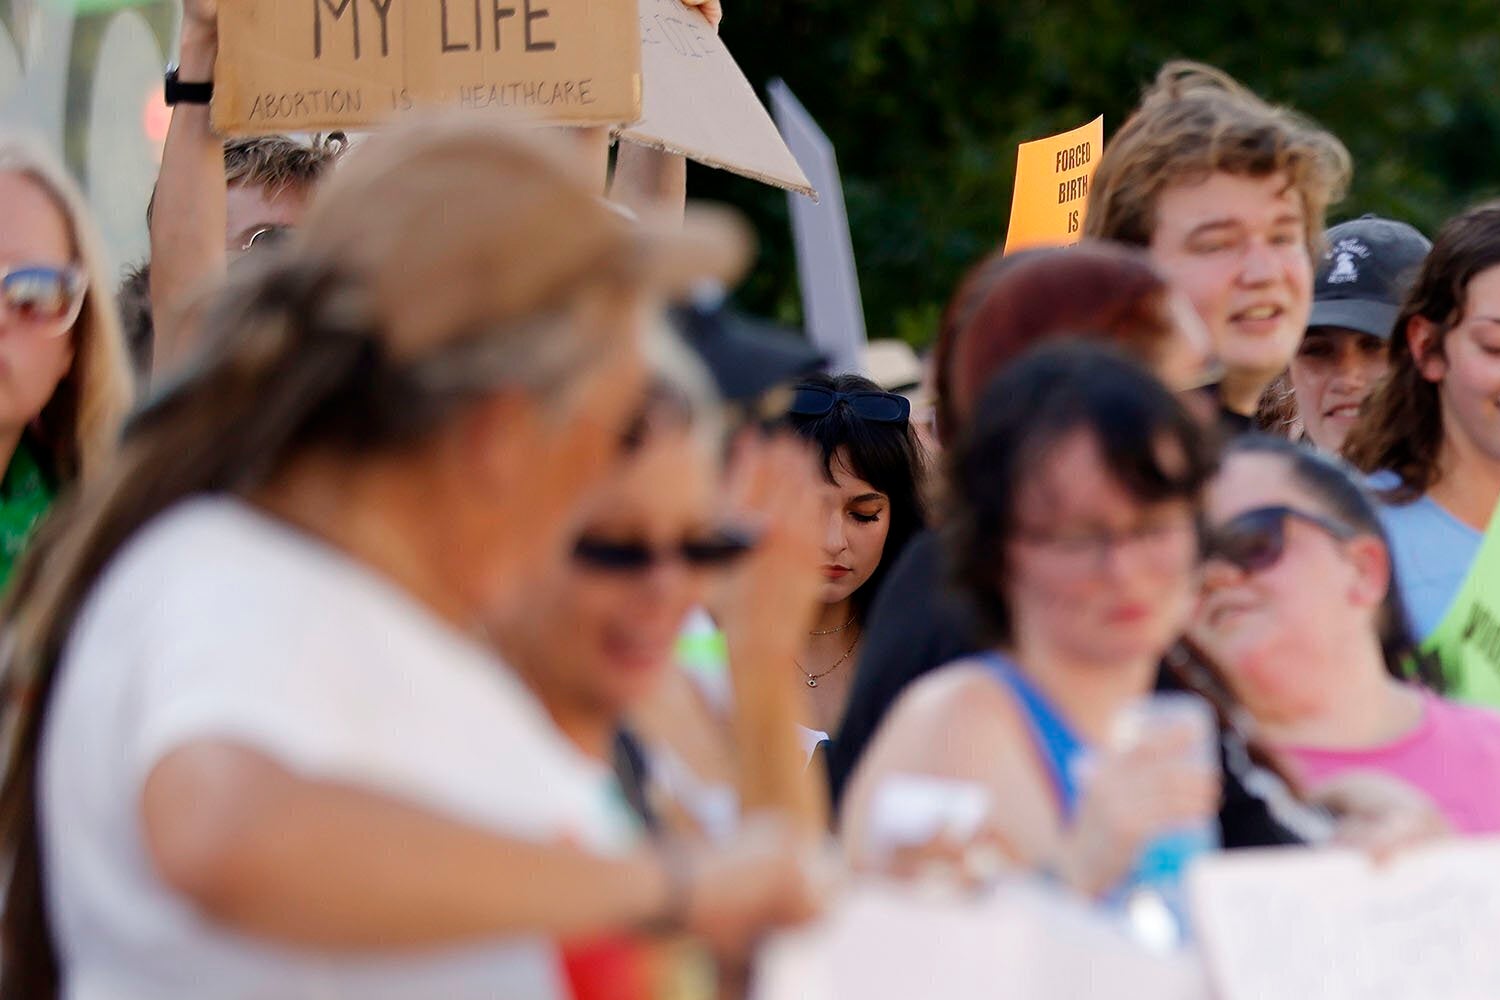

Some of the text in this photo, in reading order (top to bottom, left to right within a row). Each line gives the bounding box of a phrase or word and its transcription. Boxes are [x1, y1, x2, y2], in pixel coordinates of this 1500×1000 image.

[313, 0, 557, 60] MY LIFE
[248, 79, 597, 121] ABORTION IS HEALTHCARE
[1055, 141, 1091, 173] FORCED
[1058, 174, 1088, 205] BIRTH
[1068, 209, 1079, 234] IS
